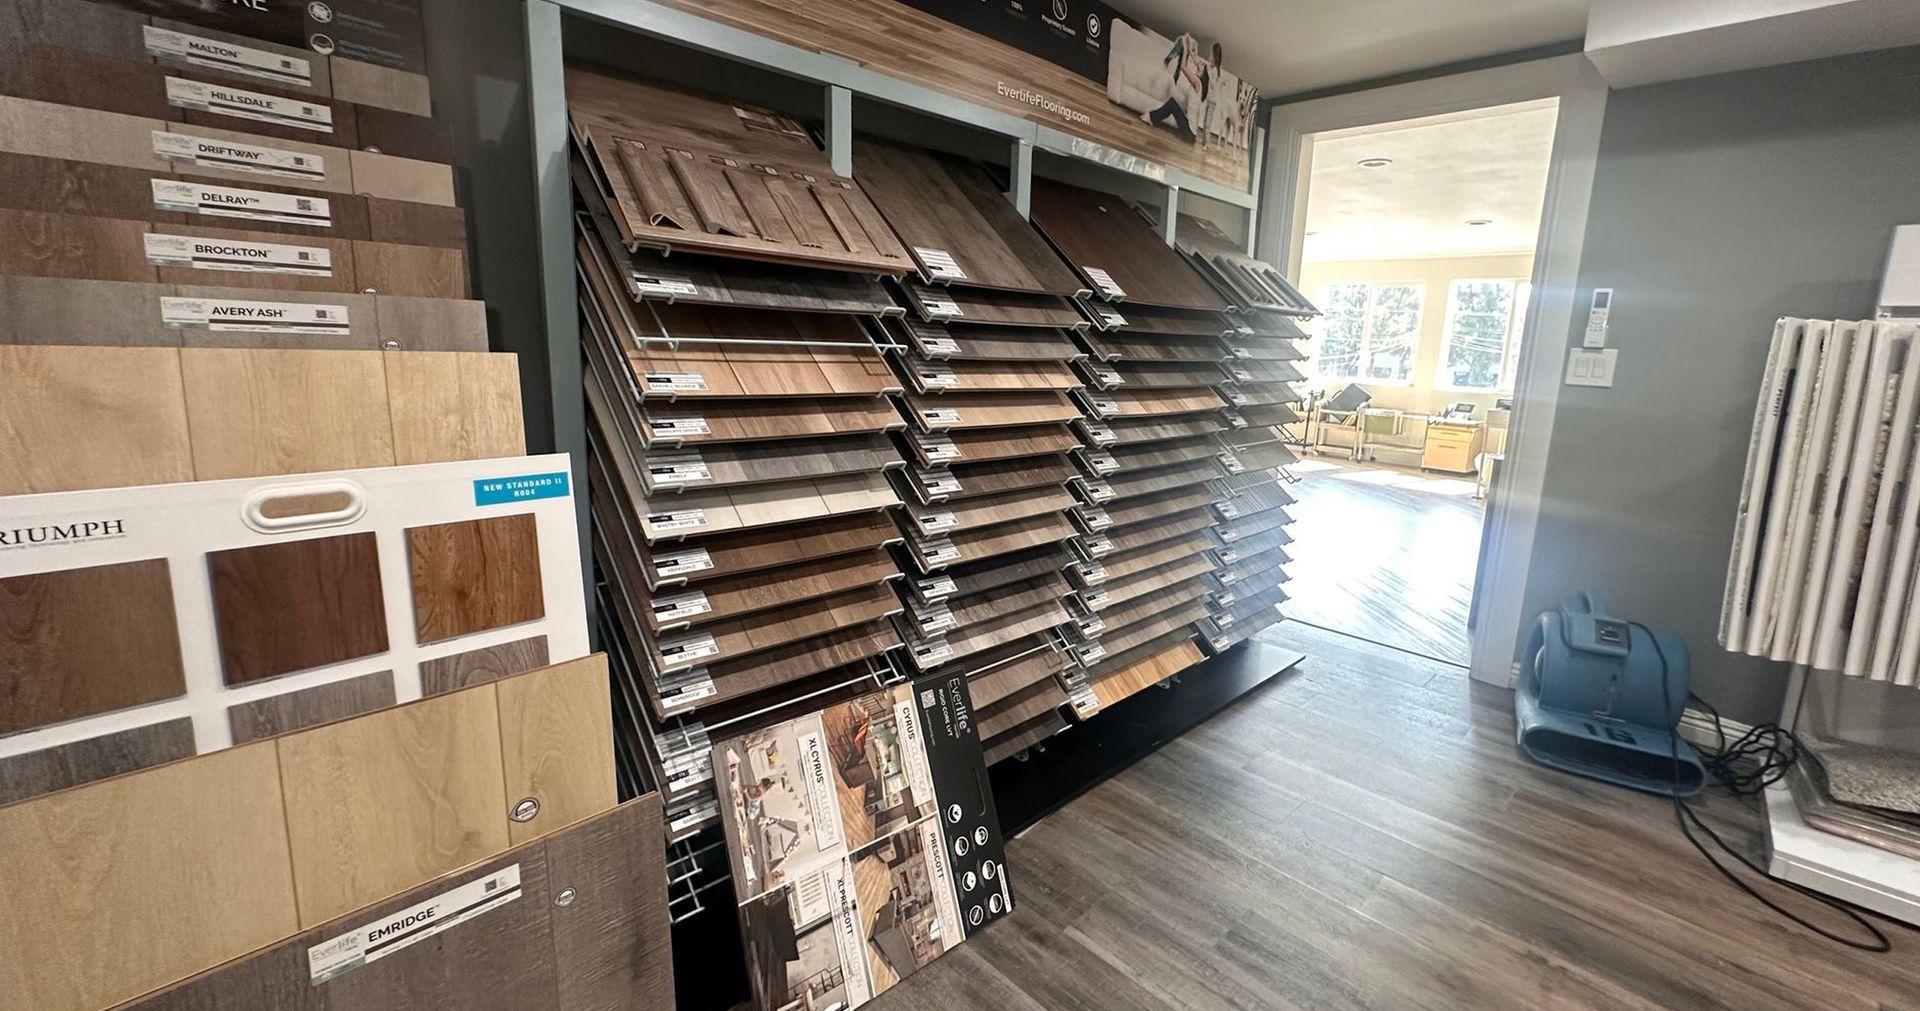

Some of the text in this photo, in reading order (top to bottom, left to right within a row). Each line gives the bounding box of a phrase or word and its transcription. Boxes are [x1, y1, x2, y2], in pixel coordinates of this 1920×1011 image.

[188, 41, 238, 59] MALTON
[210, 90, 273, 109] HILLSDALE
[997, 81, 1090, 125] EverlifeFlooring.com
[198, 144, 260, 160] DRIFTWAY
[195, 244, 268, 258] BROCKTON
[212, 306, 283, 317] AVERY ASH
[483, 483, 503, 492] NEW
[506, 478, 552, 490] STANDARD
[514, 488, 536, 497] R004
[949, 677, 969, 731] Everlife
[903, 706, 915, 740] CYRUS
[942, 706, 950, 724] CORE
[930, 832, 944, 879] PRESCOTT
[367, 906, 437, 943] EMRIDGE
